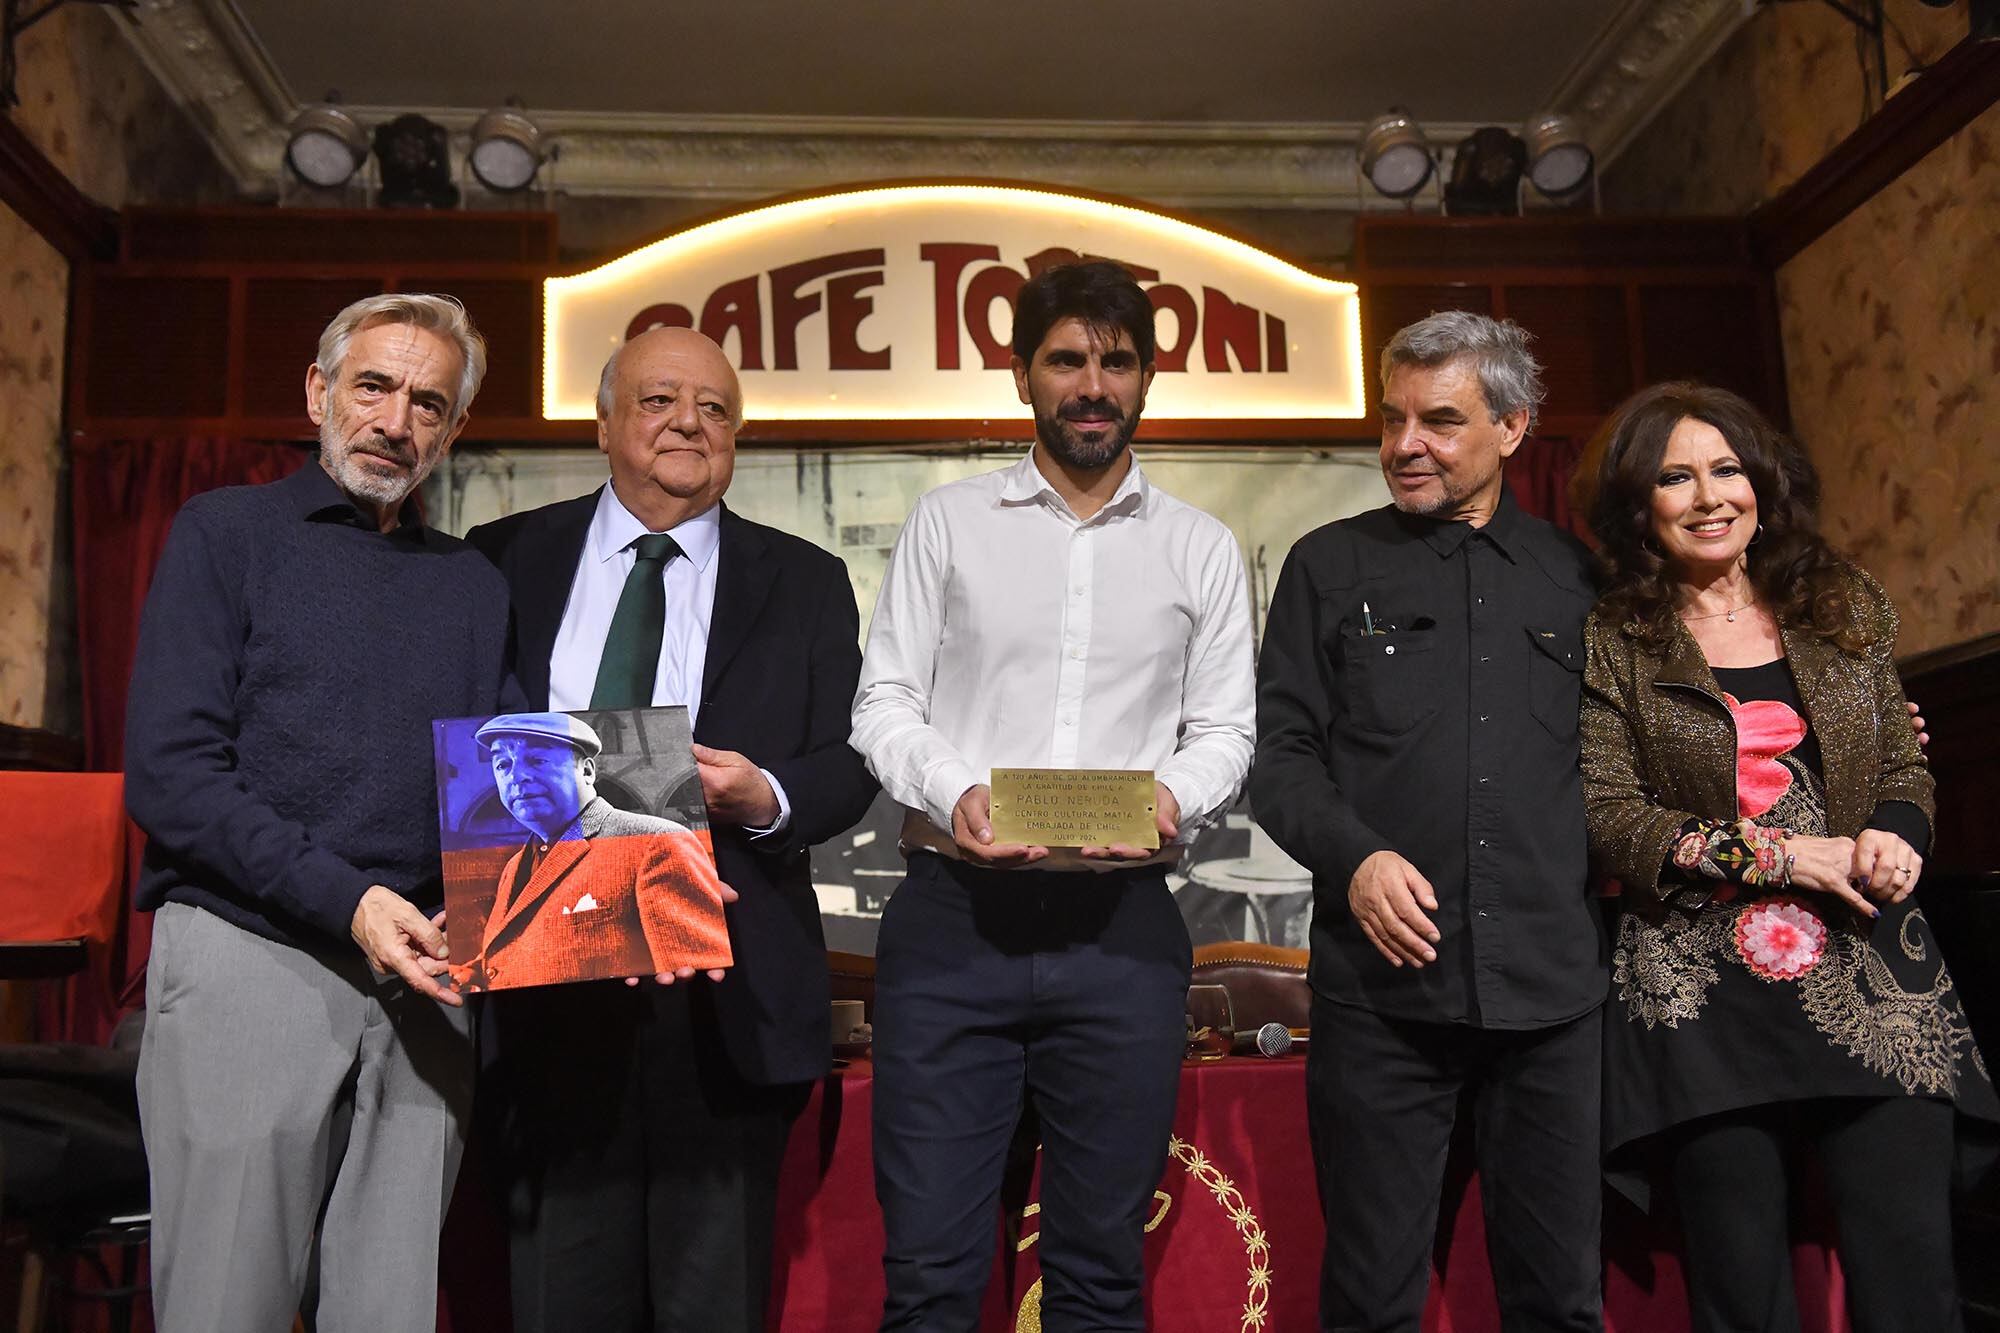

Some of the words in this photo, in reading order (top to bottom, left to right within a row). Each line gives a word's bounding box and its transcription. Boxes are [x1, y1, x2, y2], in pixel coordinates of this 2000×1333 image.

[920, 242, 1289, 373] TOONI
[1082, 775, 1146, 783] ALUMBRAMIENTO
[1016, 795, 1059, 806] PABLO
[1067, 795, 1120, 806] NERUDA
[1015, 810, 1049, 819] CENTRO
[1054, 810, 1099, 819] CULTURAL
[1104, 811, 1133, 819] MATTA
[1026, 822, 1074, 830] EMBAJADA
[1079, 822, 1090, 830] DE
[1096, 823, 1121, 831] CHILE
[1053, 833, 1075, 841] JULIO
